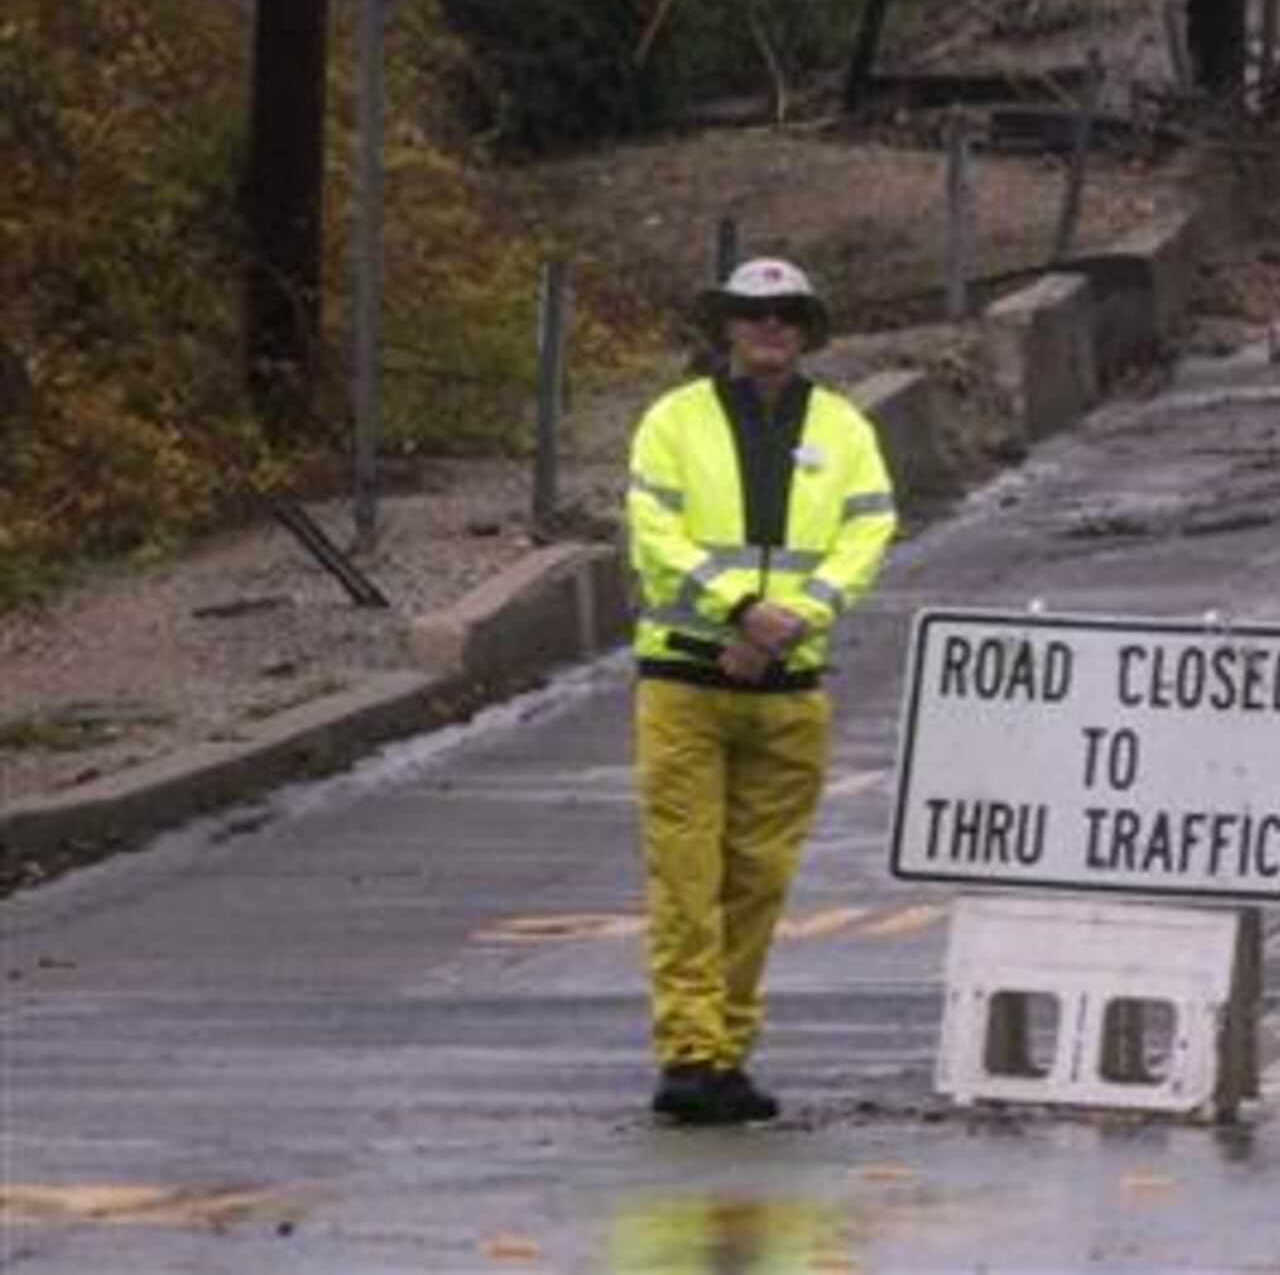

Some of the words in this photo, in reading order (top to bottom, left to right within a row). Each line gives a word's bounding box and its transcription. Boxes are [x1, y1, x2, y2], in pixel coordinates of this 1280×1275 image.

[939, 636, 1074, 702] ROAD
[1081, 727, 1139, 791] TO
[925, 799, 1048, 866] THRU
